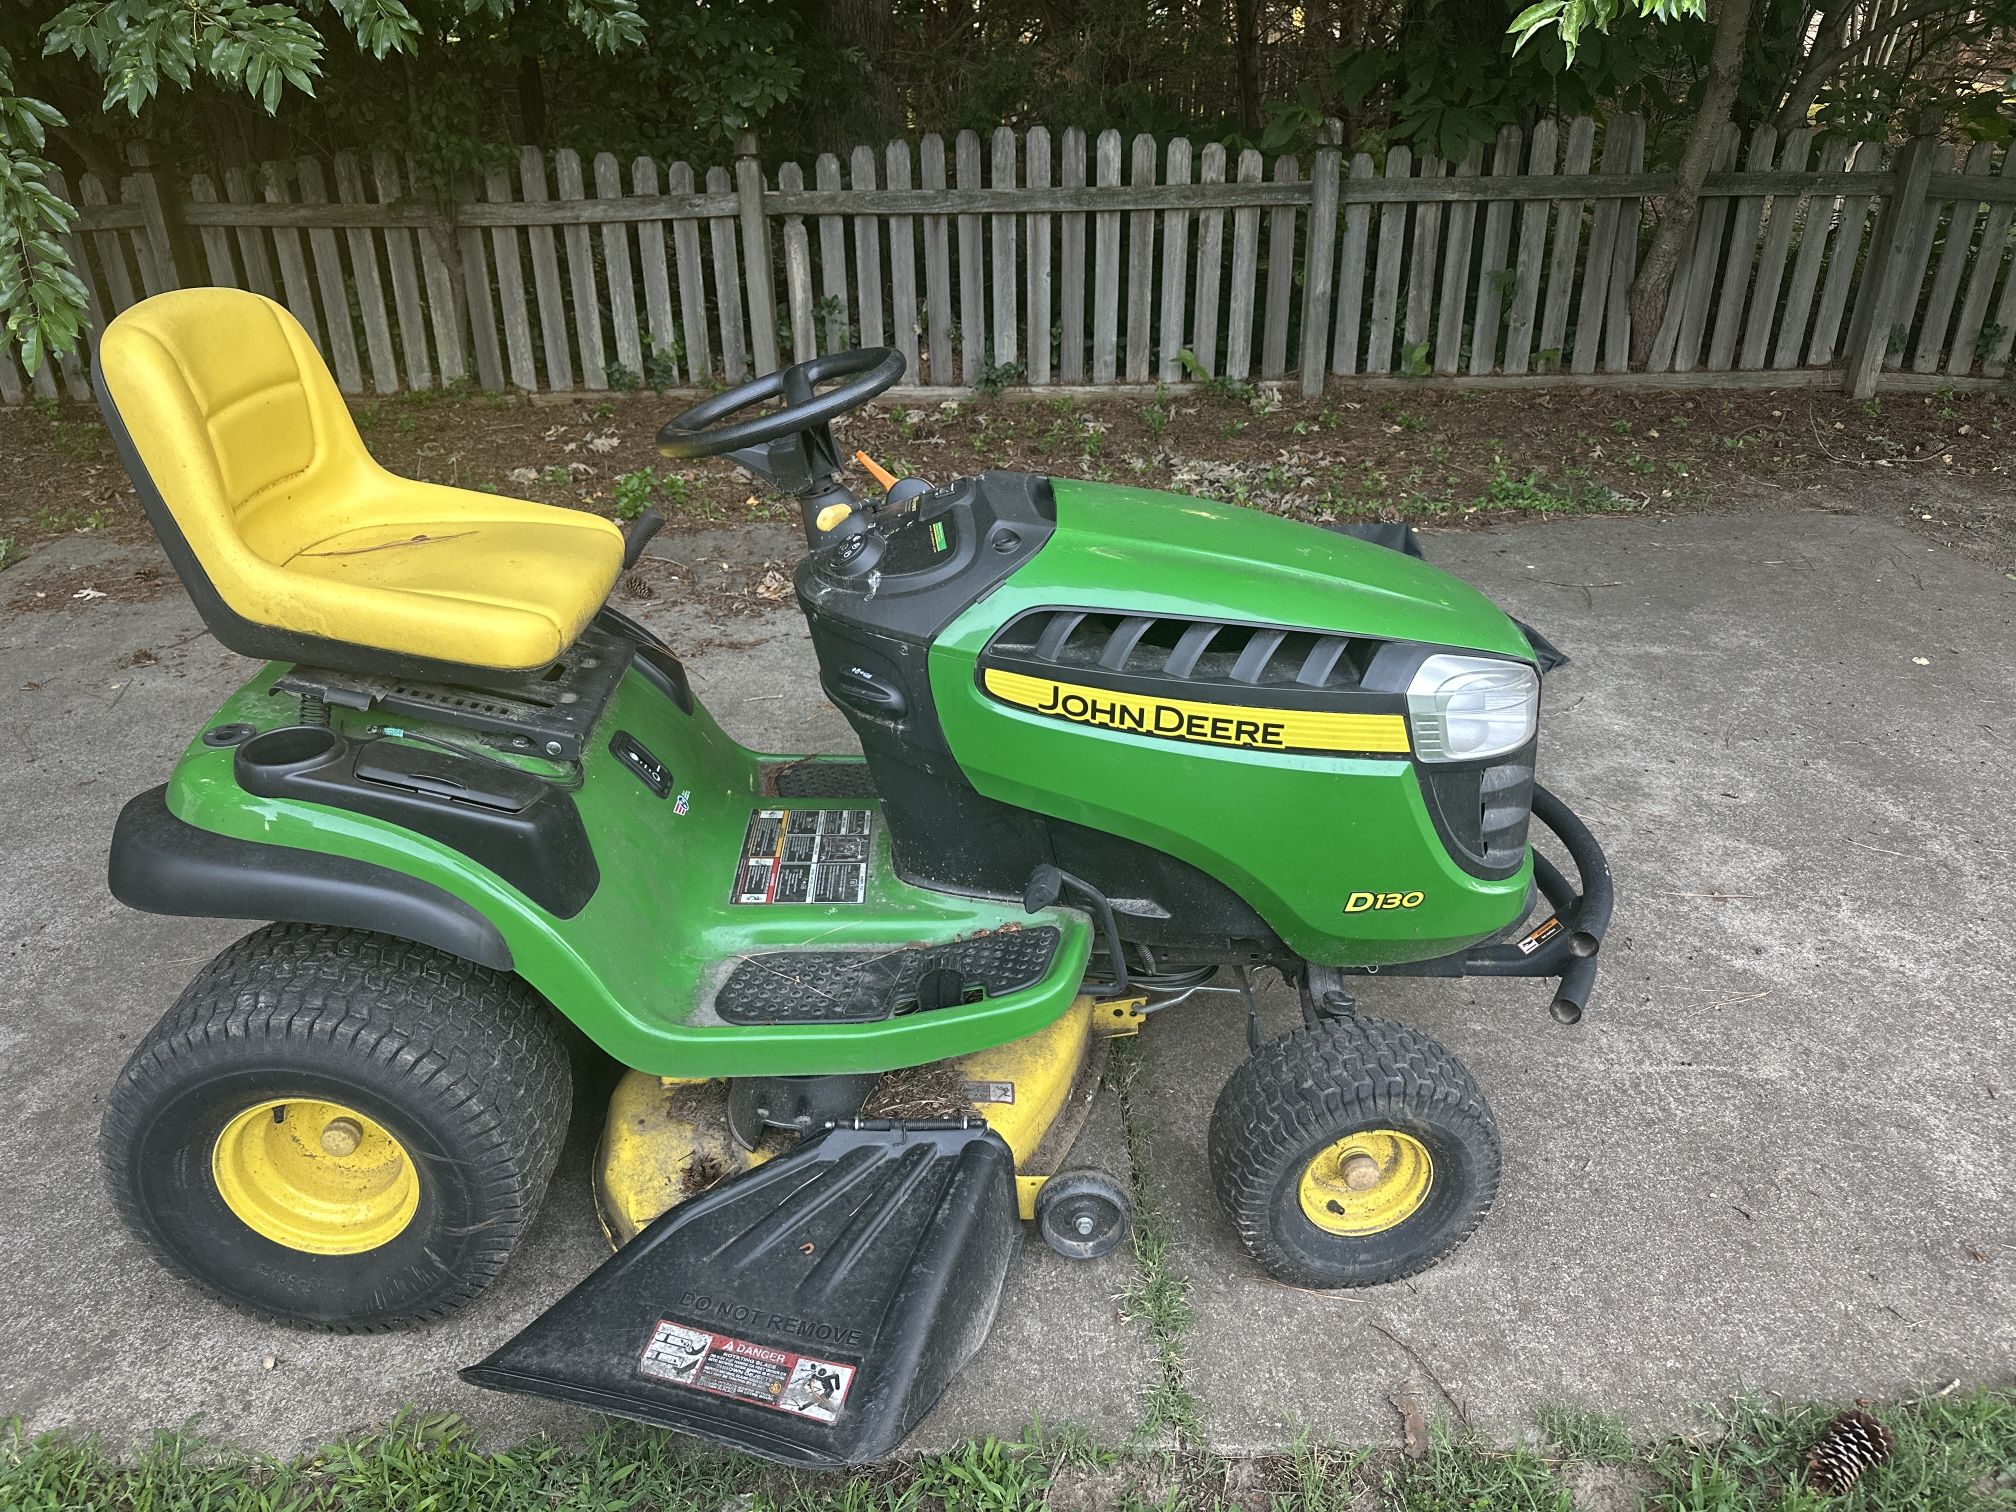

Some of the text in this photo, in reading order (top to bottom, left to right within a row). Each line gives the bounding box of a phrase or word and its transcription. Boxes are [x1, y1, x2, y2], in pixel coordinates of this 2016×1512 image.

[1038, 686, 1285, 746] JOHN DEERE
[1343, 891, 1426, 913] D130
[679, 1291, 863, 1347] DO NOT REMOVE
[736, 1344, 786, 1363] DANGER
